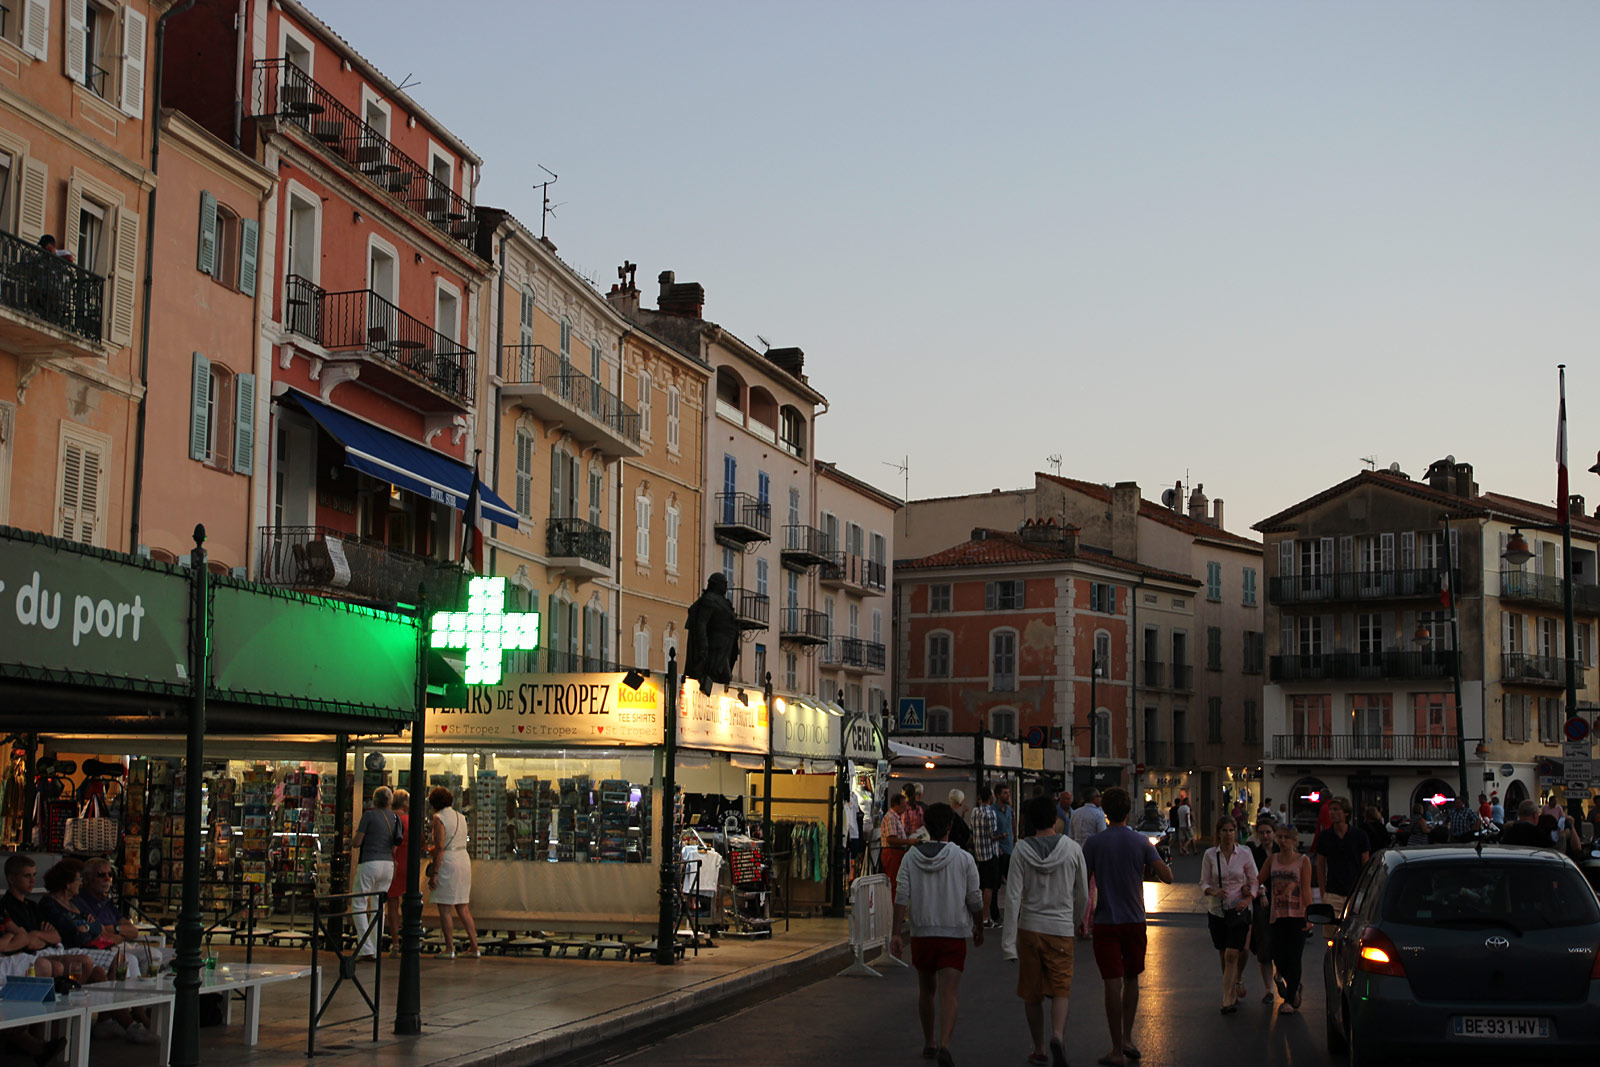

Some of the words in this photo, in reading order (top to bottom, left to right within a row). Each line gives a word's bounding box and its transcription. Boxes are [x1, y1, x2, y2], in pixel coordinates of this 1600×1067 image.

[15, 571, 61, 631] du
[72, 594, 145, 647] port
[497, 689, 514, 710] DE
[518, 682, 610, 715] ST-TROPEZ
[618, 686, 656, 704] Kodak
[618, 713, 630, 723] TEE
[632, 713, 656, 723] SHIRTS
[463, 725, 500, 735] Tropez
[541, 725, 577, 735] Tropez
[620, 725, 657, 735] Tropez
[785, 718, 830, 746] promod
[852, 725, 876, 752] CECILE
[1465, 1019, 1536, 1034] BE-931-WV
